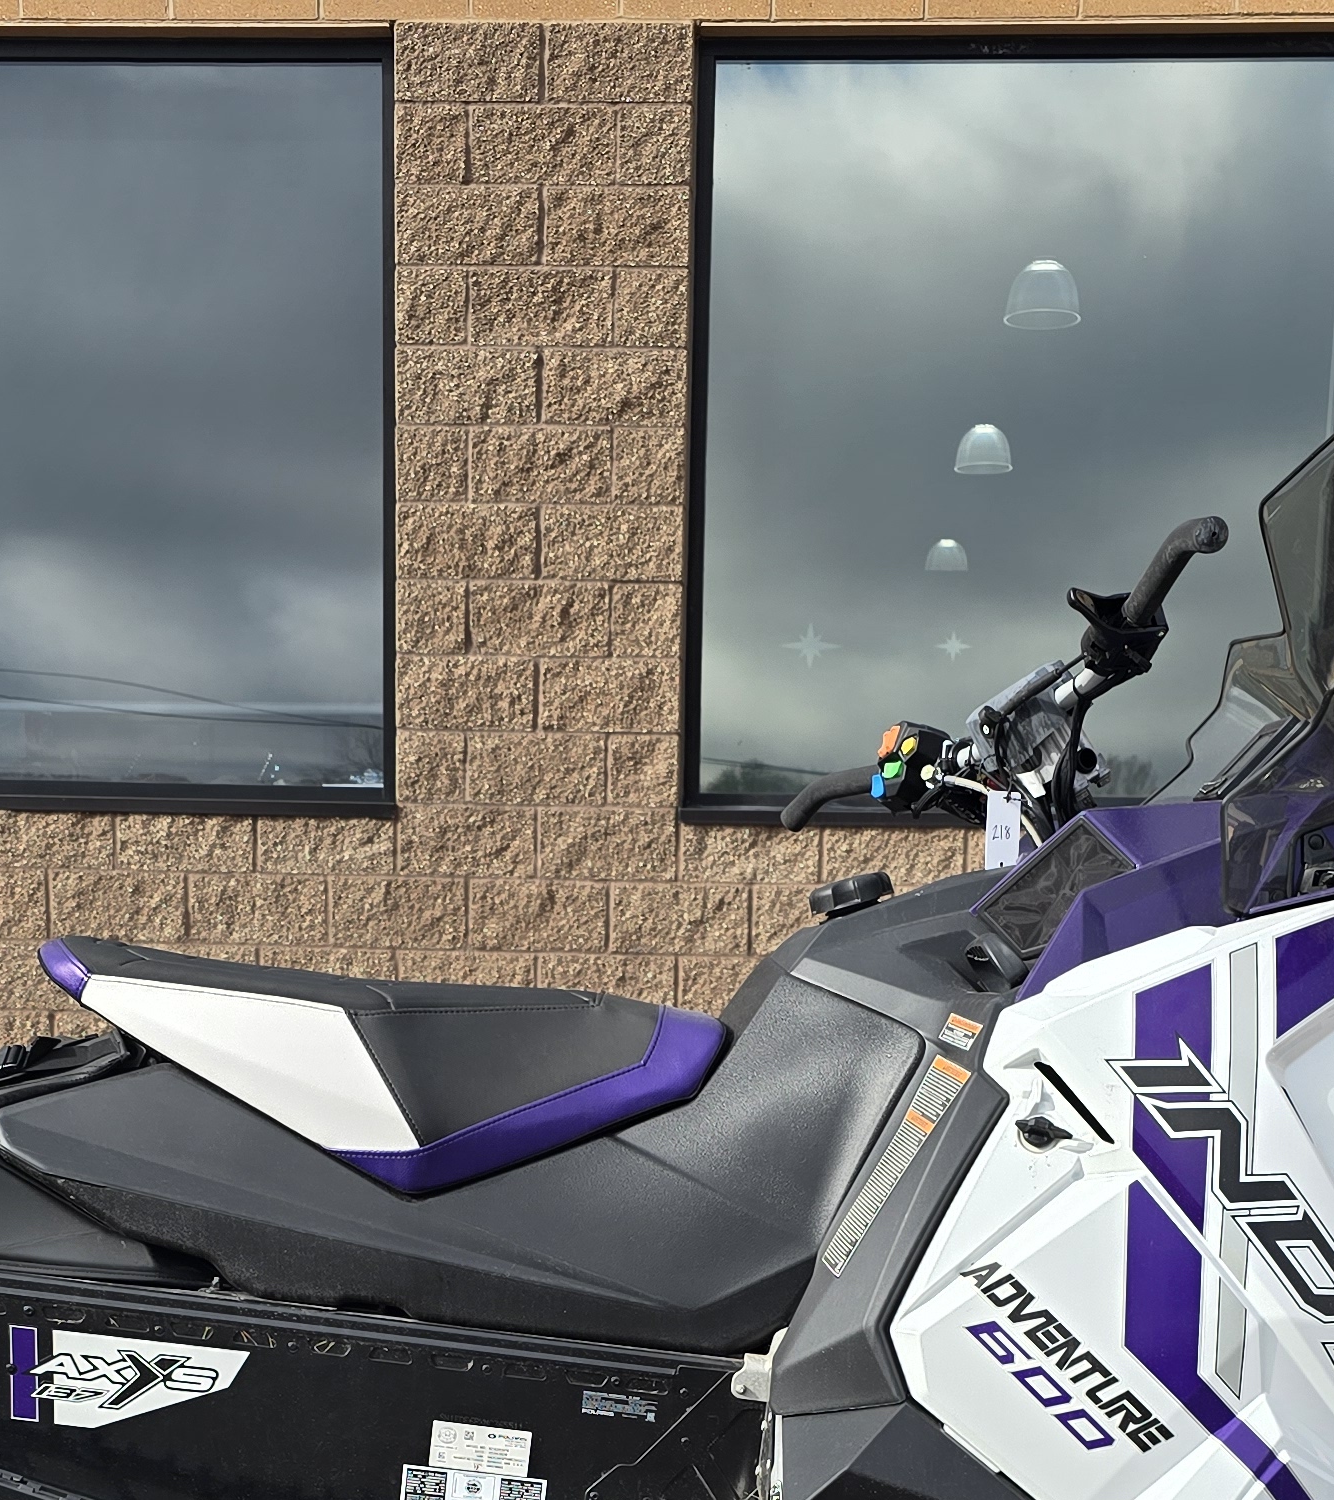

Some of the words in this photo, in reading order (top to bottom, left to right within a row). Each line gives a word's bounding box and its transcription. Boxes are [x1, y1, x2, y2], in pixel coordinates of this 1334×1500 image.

[992, 824, 1011, 840] 218
[28, 1349, 220, 1410] AXYS
[959, 1261, 1175, 1453] ADVENTURE
[962, 1320, 1116, 1451] 600
[30, 1382, 111, 1403] 137
